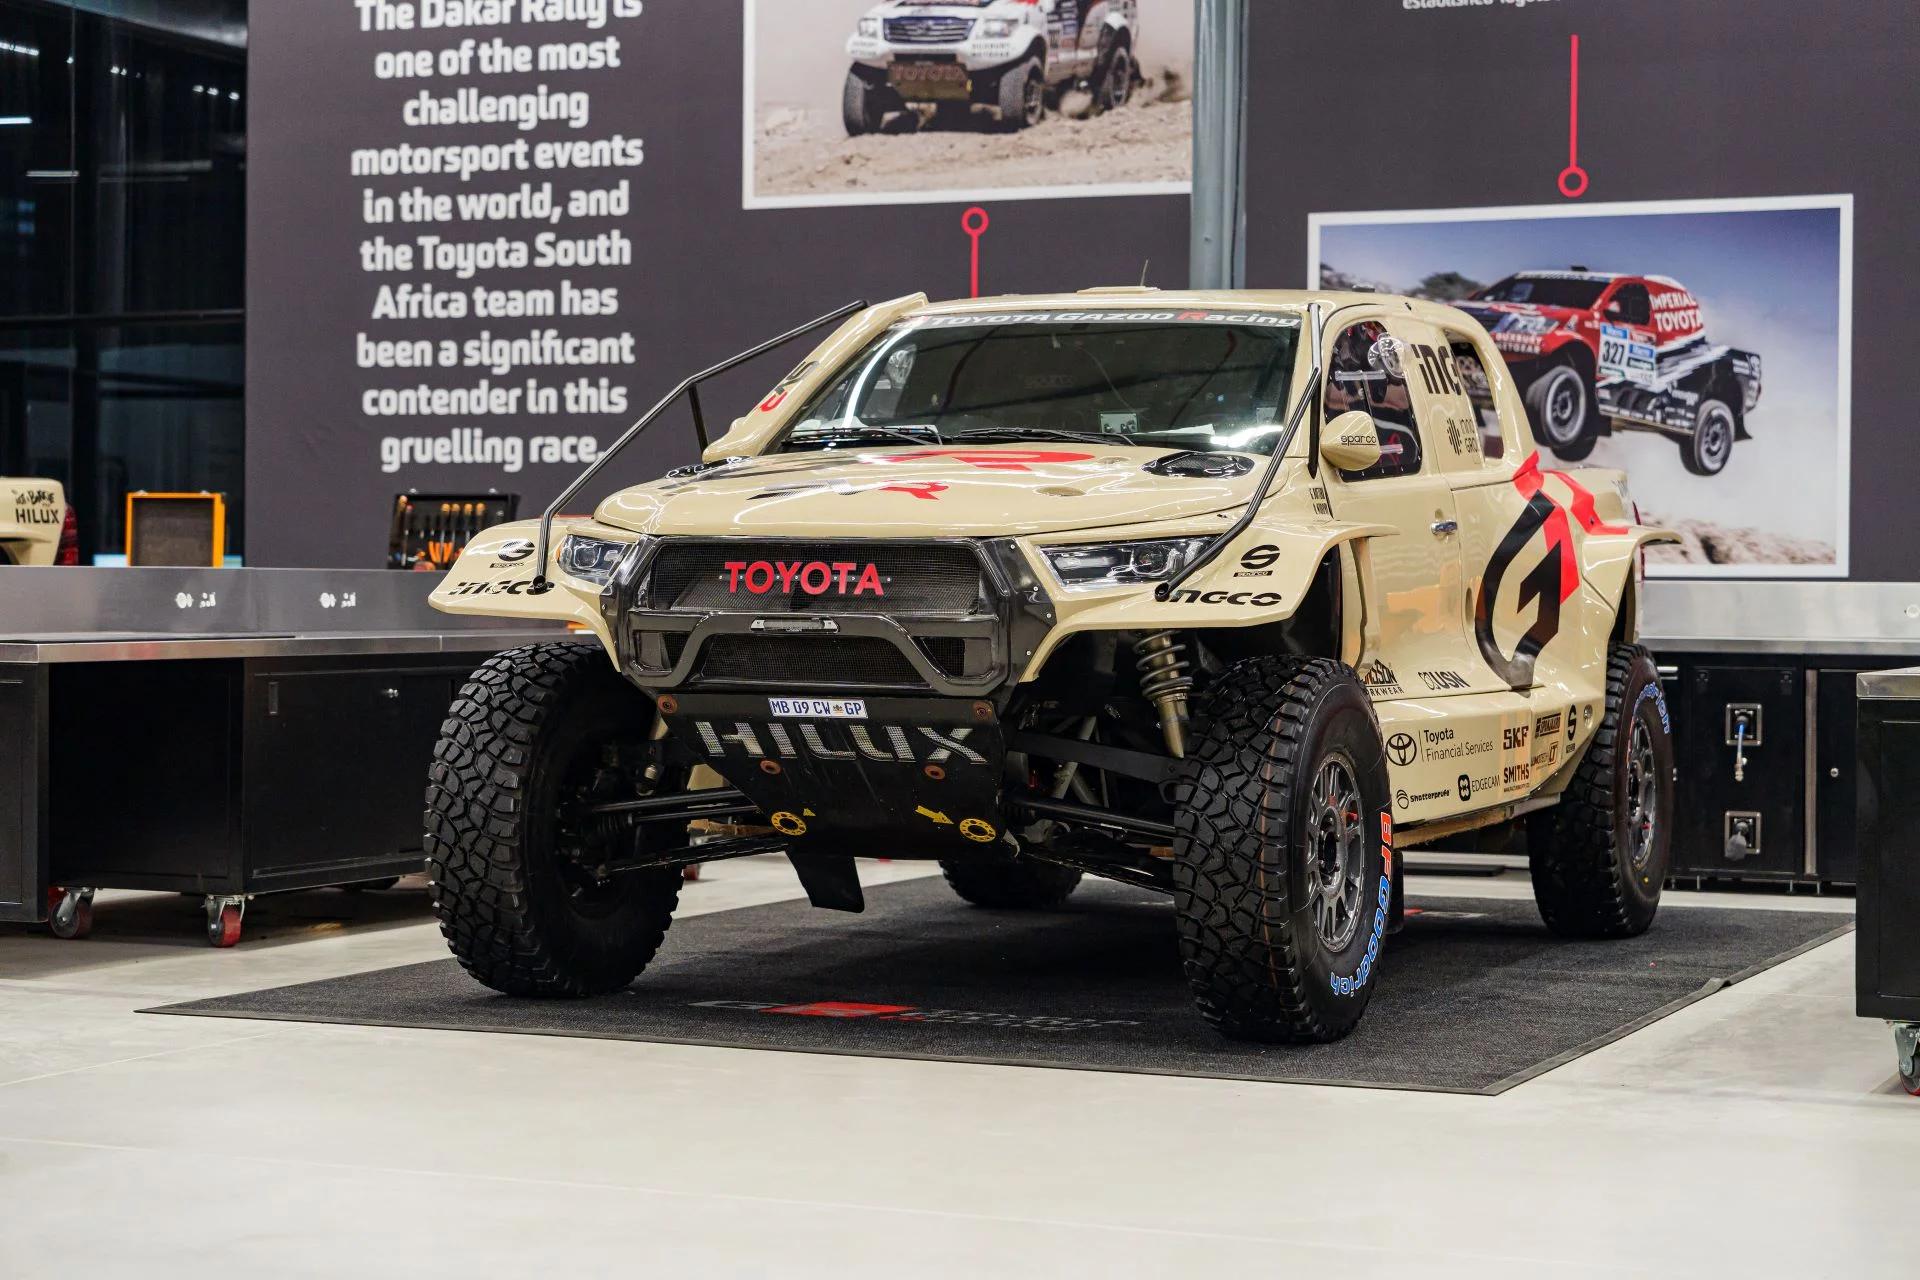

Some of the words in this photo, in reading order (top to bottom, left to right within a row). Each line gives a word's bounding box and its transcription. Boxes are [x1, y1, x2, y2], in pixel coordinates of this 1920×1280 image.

[354, 0, 415, 31] The
[420, 0, 517, 28] Dakar
[521, 0, 607, 29] Rally
[374, 50, 434, 78] one
[438, 38, 476, 77] of
[477, 37, 533, 73] the
[538, 36, 621, 71] most
[403, 84, 589, 131] challenging
[351, 138, 530, 181] motorsport
[534, 134, 644, 169] events
[363, 188, 394, 223] in
[398, 186, 453, 222] the
[456, 182, 563, 224] world,
[567, 179, 630, 217] and
[359, 236, 413, 272] the
[417, 235, 529, 279] Toyota
[534, 229, 632, 268] South
[371, 283, 468, 320] Africa
[472, 286, 555, 318] team
[561, 279, 619, 316] has
[932, 313, 1051, 327] TOYOTA
[1053, 312, 1175, 322] GAZOO
[1175, 311, 1301, 328] Racing
[357, 332, 433, 368] been
[438, 340, 458, 367] a
[463, 328, 636, 376] significant
[1602, 341, 1626, 366] 327
[362, 379, 522, 416] contender
[526, 378, 558, 414] in
[563, 377, 628, 414] this
[381, 427, 524, 473] gruelling
[15, 508, 60, 524] HILUX
[723, 561, 885, 597] TOYOTA
[771, 700, 791, 714] MB
[793, 701, 810, 714] 09
[813, 701, 832, 715] CW
[844, 702, 862, 716] GP
[695, 721, 988, 765] HILUX
[1424, 727, 1454, 746] Toyota
[1426, 742, 1464, 762] Financial
[1465, 739, 1495, 757] Services
[1503, 725, 1530, 751] SKF
[1471, 774, 1501, 793] EDGECAM
[1503, 763, 1530, 784] SMITHS
